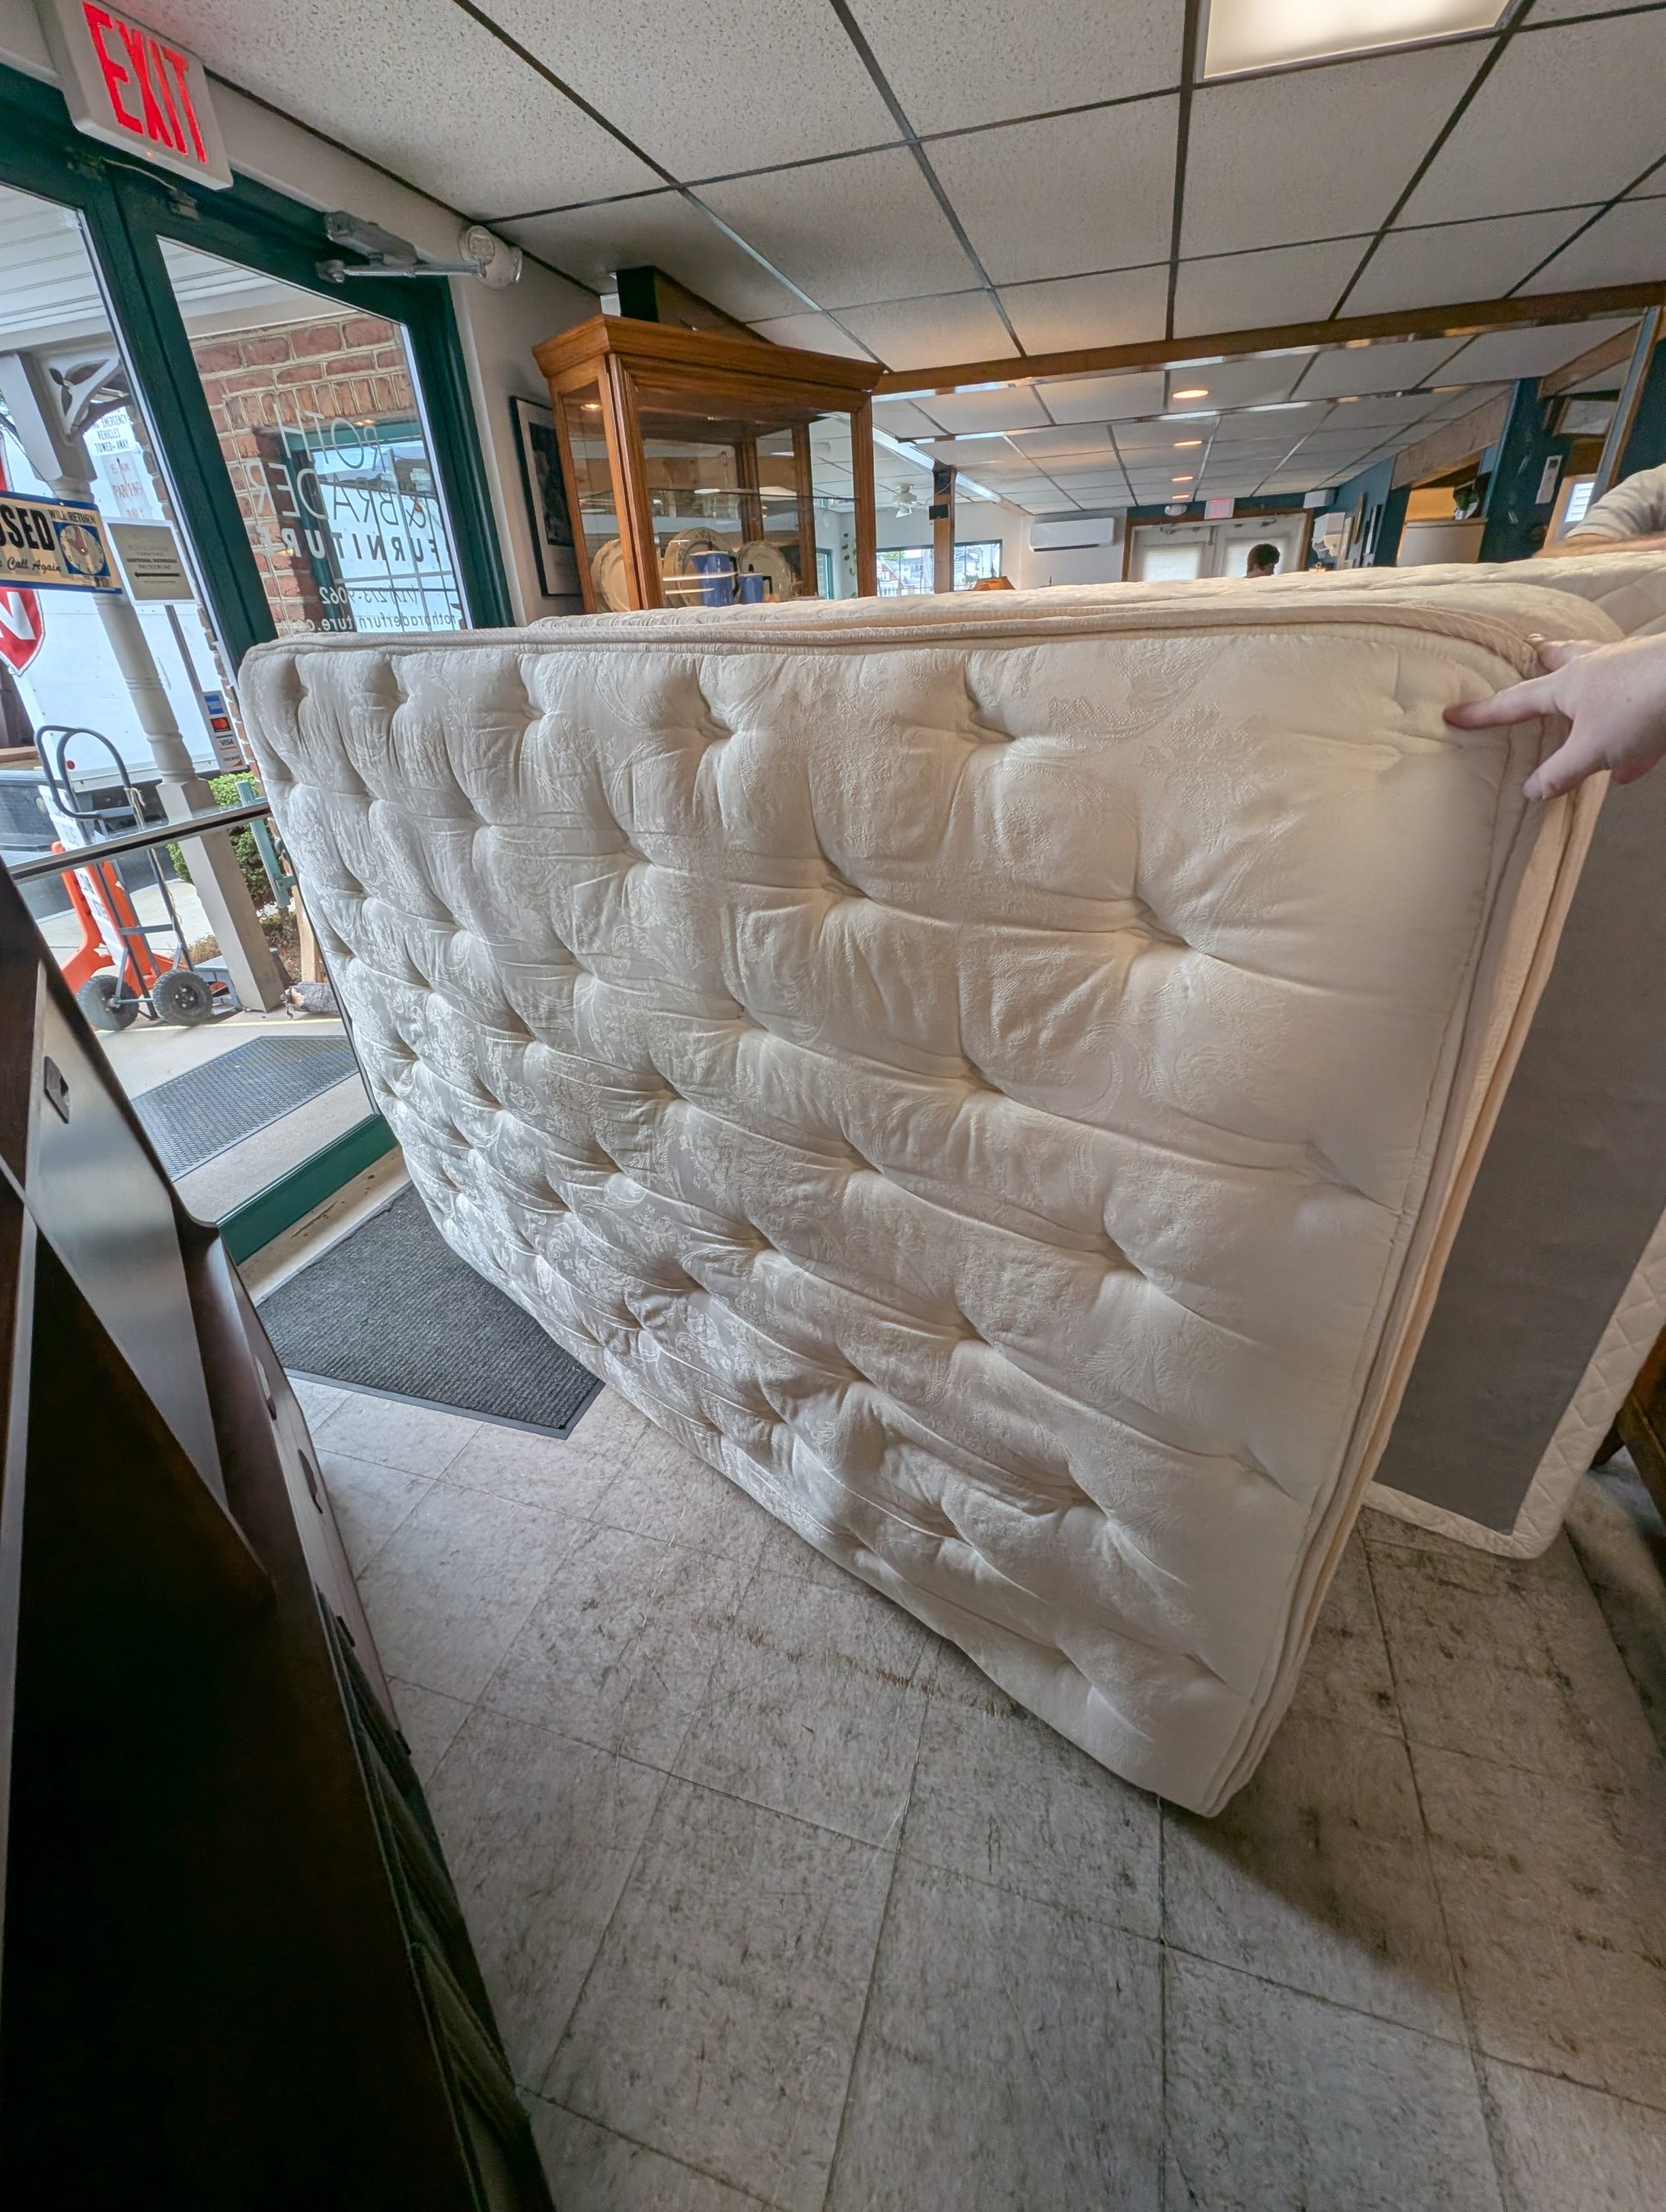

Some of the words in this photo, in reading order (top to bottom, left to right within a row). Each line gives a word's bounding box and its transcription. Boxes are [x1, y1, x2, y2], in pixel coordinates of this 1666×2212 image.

[83, 2, 207, 163] EXIT
[48, 509, 68, 521] WILL
[68, 512, 97, 524] RETURN
[0, 504, 55, 550] SED
[7, 556, 29, 570] Call
[32, 559, 62, 574] Again
[219, 738, 234, 747] VISA
